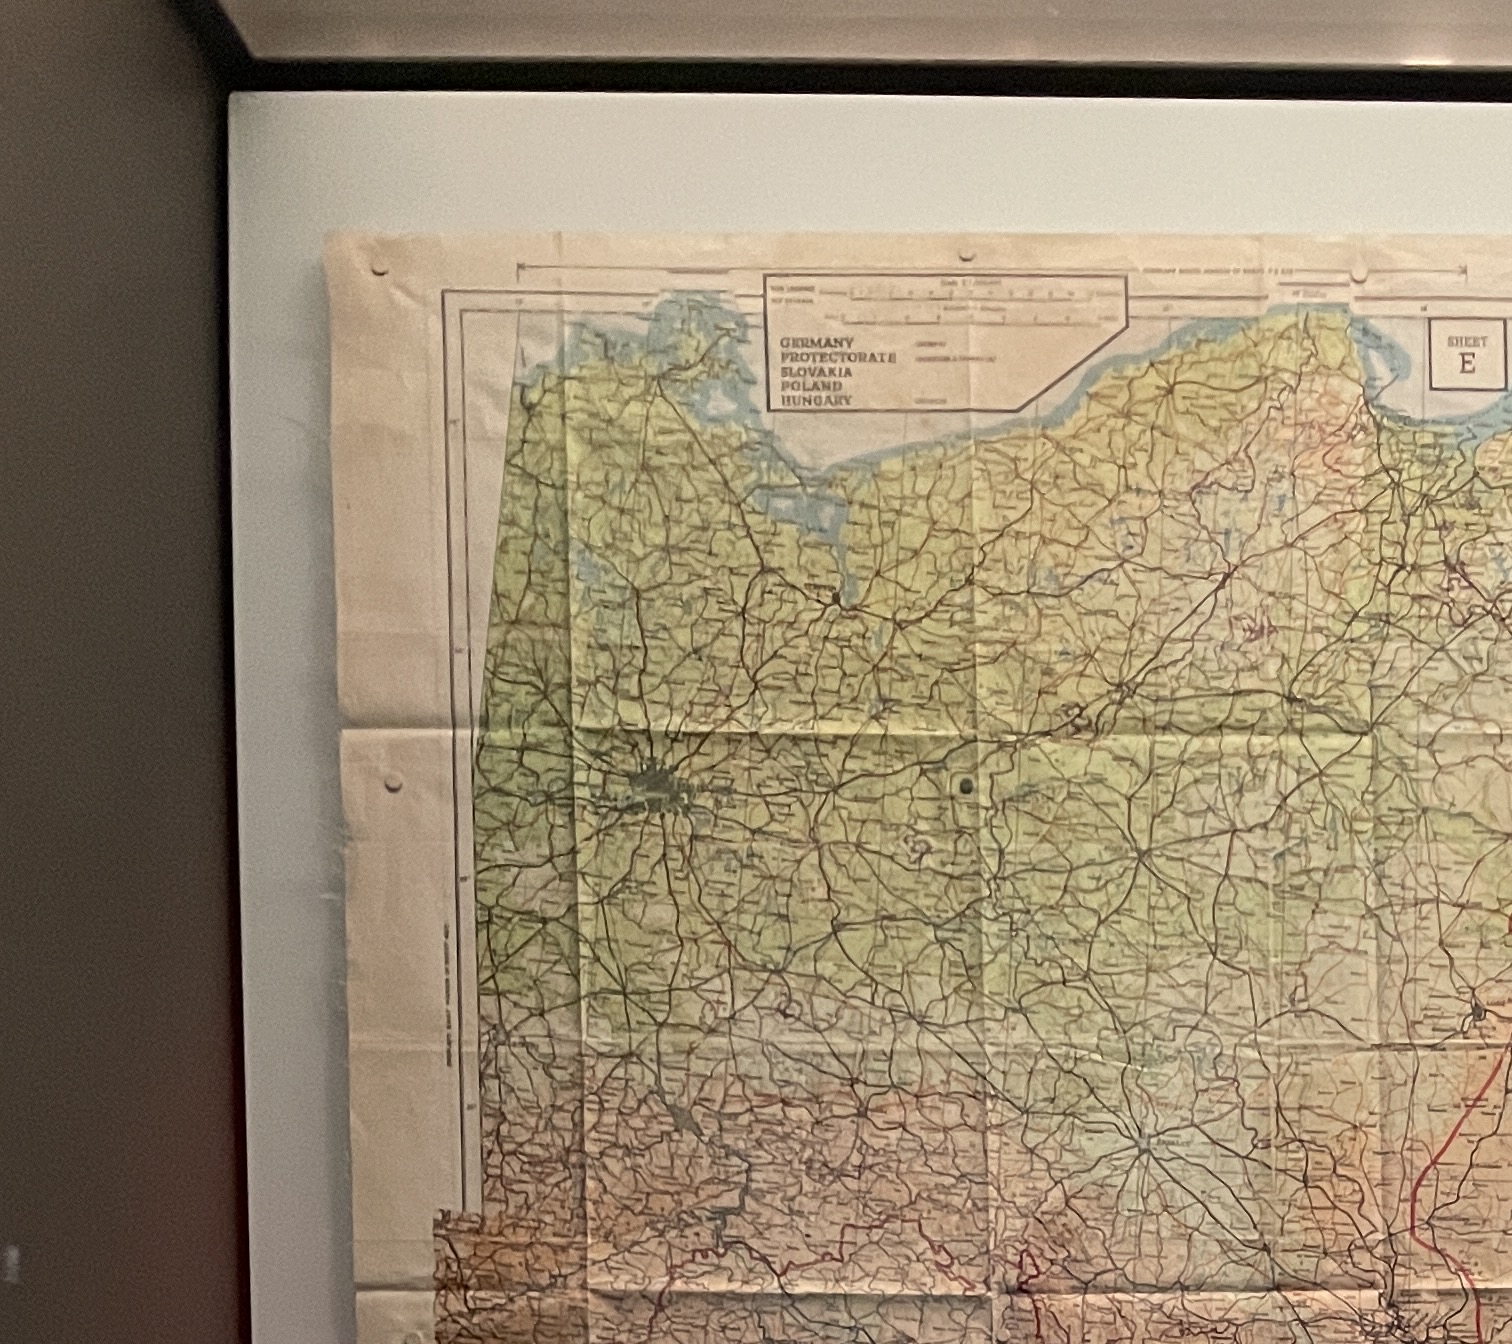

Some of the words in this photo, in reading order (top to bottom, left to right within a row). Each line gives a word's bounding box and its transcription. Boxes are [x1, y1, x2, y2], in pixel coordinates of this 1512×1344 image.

[780, 337, 854, 349] GERMANY
[1447, 335, 1488, 348] SHEET
[780, 352, 897, 363] PROTECTORATE
[1459, 351, 1476, 374] E
[780, 367, 853, 379] SLOVAKIA
[780, 381, 843, 393] POLAND
[780, 395, 853, 406] HUNGARY
